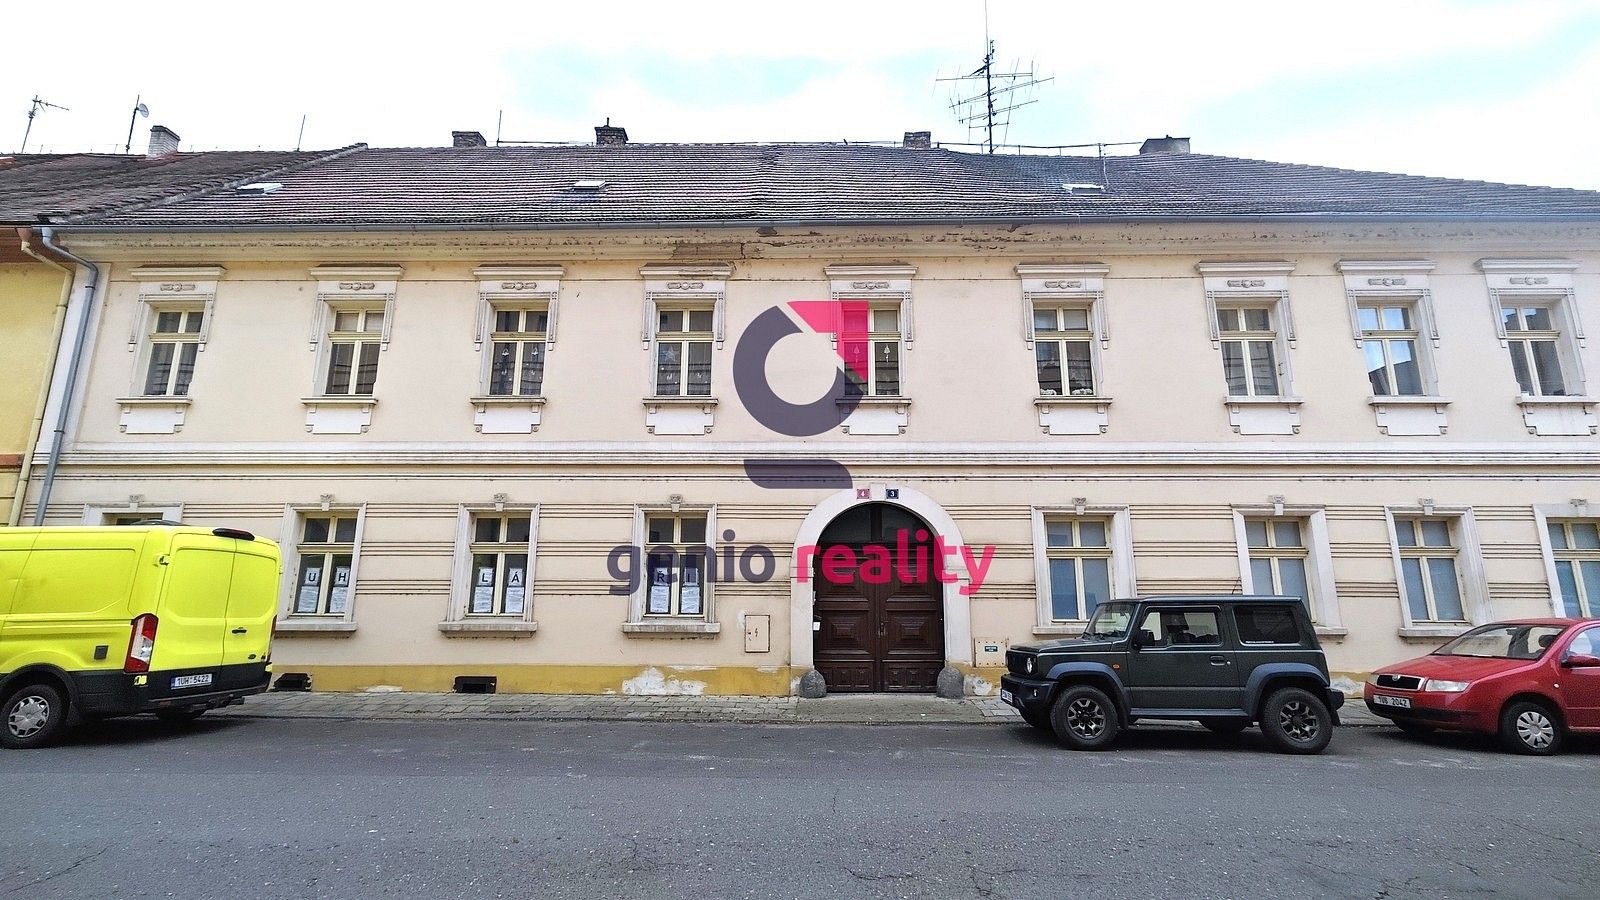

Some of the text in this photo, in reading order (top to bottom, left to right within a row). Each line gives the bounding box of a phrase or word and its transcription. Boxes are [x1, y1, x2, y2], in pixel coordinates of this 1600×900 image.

[308, 572, 317, 582] U
[338, 572, 347, 582] H
[481, 572, 489, 583] L
[511, 571, 520, 583] Á
